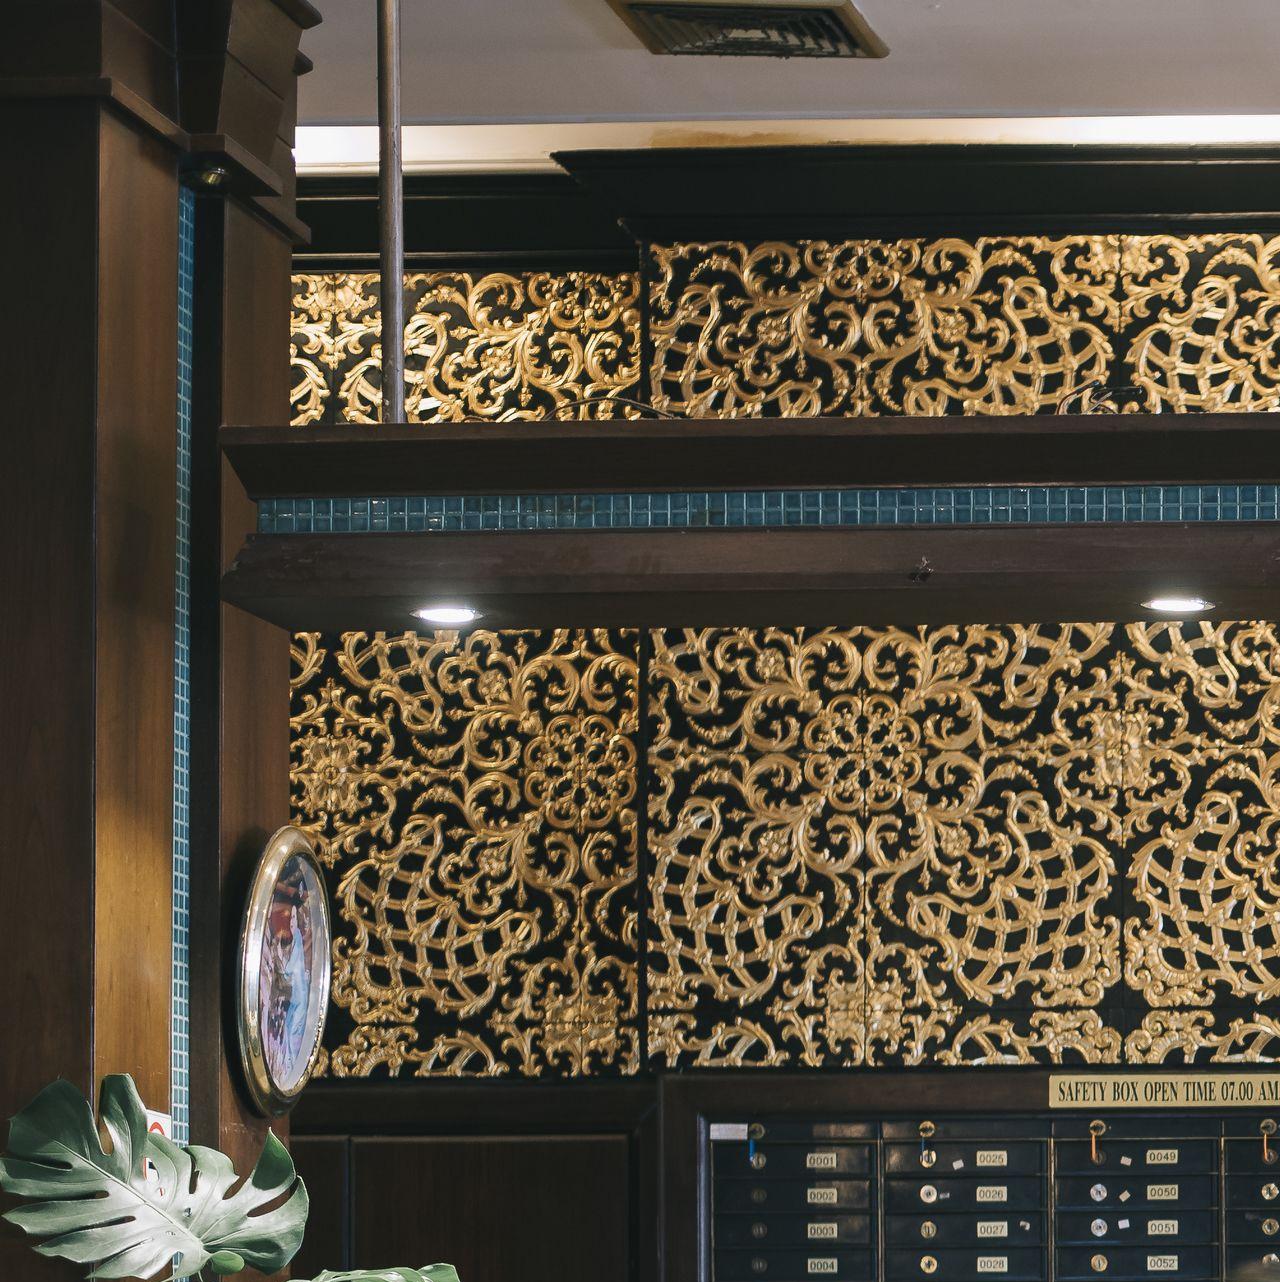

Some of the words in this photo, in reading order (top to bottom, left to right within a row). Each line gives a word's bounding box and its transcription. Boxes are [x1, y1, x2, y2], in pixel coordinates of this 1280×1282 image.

[1058, 1081, 1107, 1102] SAFETY
[1112, 1081, 1138, 1102] BOX
[1144, 1081, 1178, 1102] OPEN
[1183, 1081, 1216, 1102] TIME
[1221, 1081, 1253, 1101] 07.00
[809, 1156, 833, 1166] 0001
[979, 1154, 1004, 1164] 0025
[1149, 1152, 1176, 1162] 0049
[810, 1191, 834, 1201] 0002
[979, 1189, 1004, 1200] 0026
[1150, 1187, 1176, 1197] 0050
[810, 1226, 834, 1236] 0003
[980, 1225, 1004, 1235] 0027
[1150, 1223, 1175, 1232] 0051
[810, 1261, 834, 1271] 0004
[980, 1260, 1004, 1269] 0028
[1150, 1258, 1175, 1268] 0052
